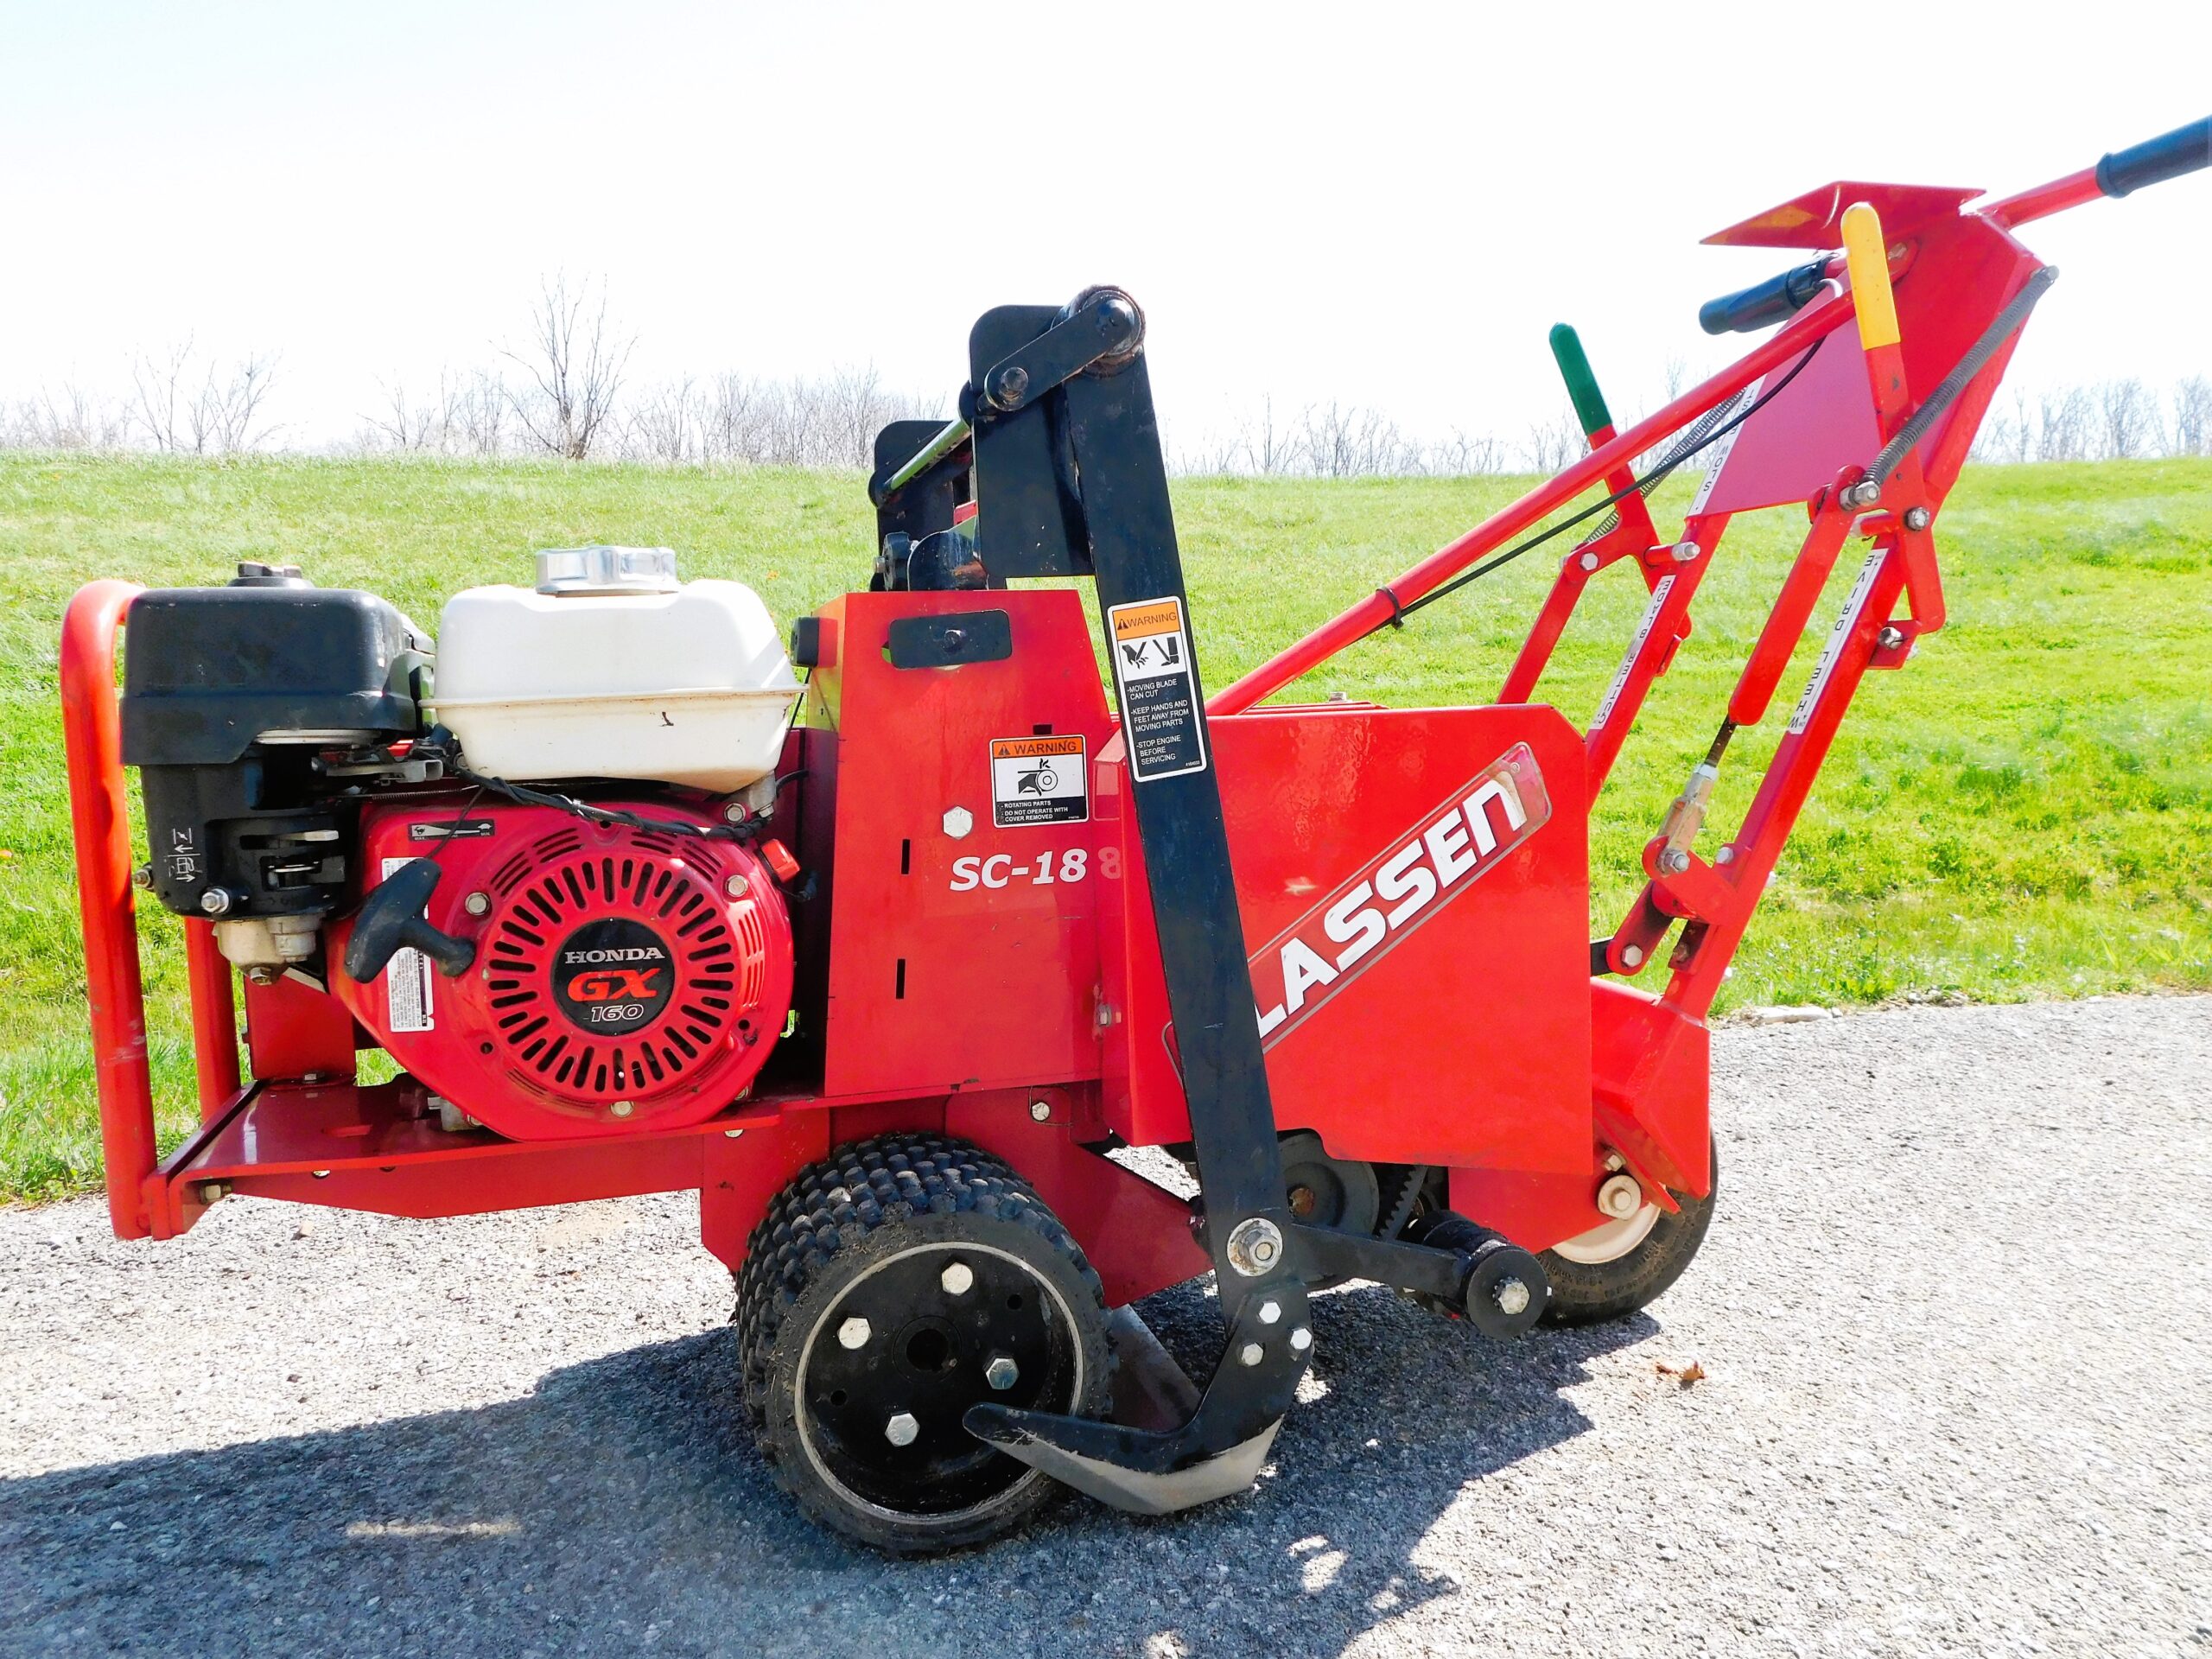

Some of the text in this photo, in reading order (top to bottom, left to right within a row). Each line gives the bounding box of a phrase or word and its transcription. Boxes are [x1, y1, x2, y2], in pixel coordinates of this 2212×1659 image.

[1704, 389, 1755, 492] SLOW FST
[1127, 612, 1177, 627] WARNING
[1789, 555, 1874, 728] WHEEL DRIVE
[1599, 580, 1671, 724] CUTTER BLADE
[1156, 679, 1178, 689] BLADE
[1145, 690, 1159, 698] CUT
[1151, 702, 1173, 712] HANDS
[1134, 709, 1189, 724] FEET AWAY FROM
[1135, 718, 1184, 733] MOVING PARTS
[1156, 734, 1182, 745] ENGINE
[1014, 741, 1077, 754] WARNING
[1140, 747, 1166, 757] BEFORE
[1141, 753, 1176, 766] SERVICING
[1027, 807, 1053, 816] OPERATE
[949, 848, 1088, 892] SC-18
[1254, 775, 1526, 1039] LASSEN
[565, 947, 665, 964] HONDA
[567, 967, 662, 1002] GX
[591, 1003, 645, 1023] 160
